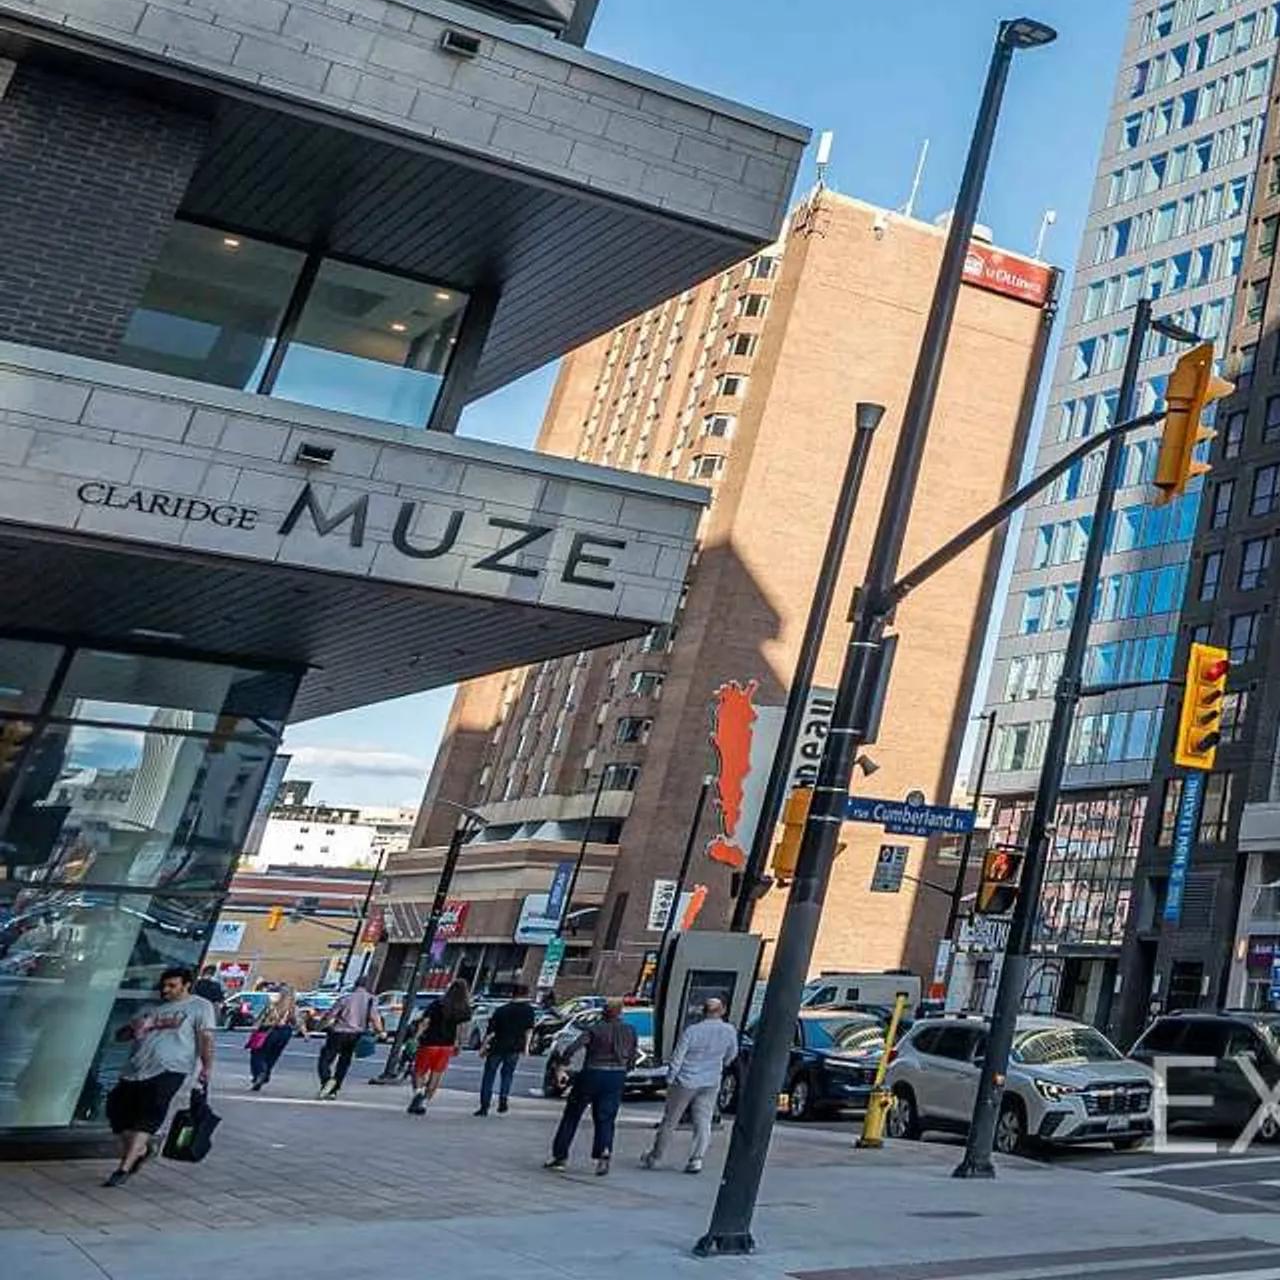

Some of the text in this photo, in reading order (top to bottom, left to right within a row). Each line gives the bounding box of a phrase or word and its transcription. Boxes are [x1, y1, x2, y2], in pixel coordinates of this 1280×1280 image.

[77, 482, 628, 591] CLARIDGE MUZE
[873, 804, 954, 828] Cumberland
